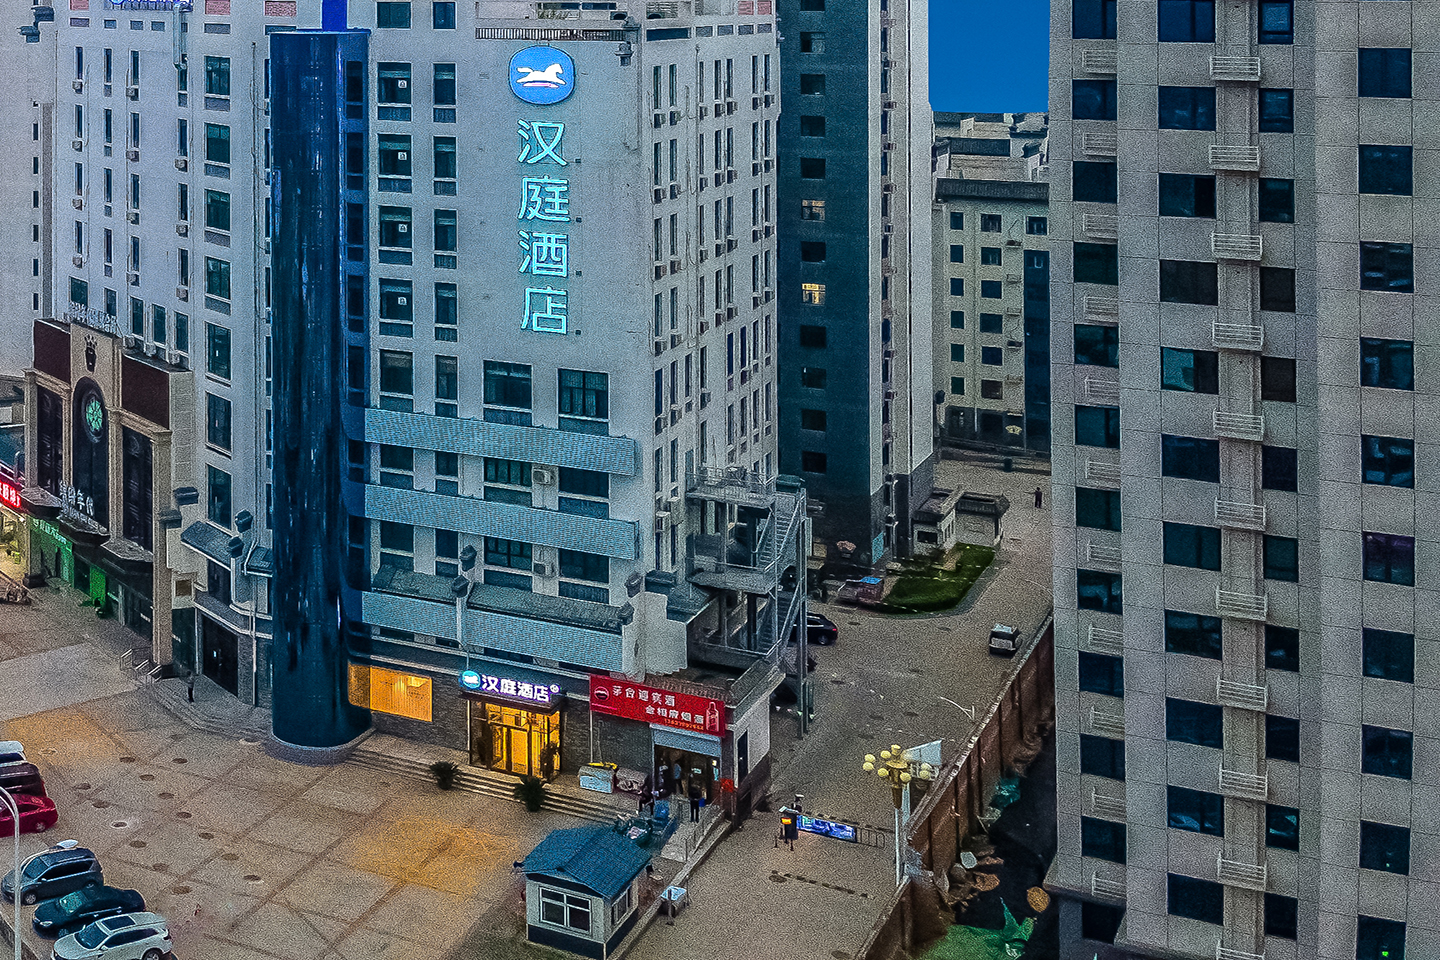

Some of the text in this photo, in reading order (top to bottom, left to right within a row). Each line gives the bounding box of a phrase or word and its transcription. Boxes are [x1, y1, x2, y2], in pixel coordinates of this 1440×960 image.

[517, 118, 570, 336] 汉庭酒店
[481, 674, 550, 702] 汉庭酒店
[611, 685, 676, 707] 茅台迎宾酒
